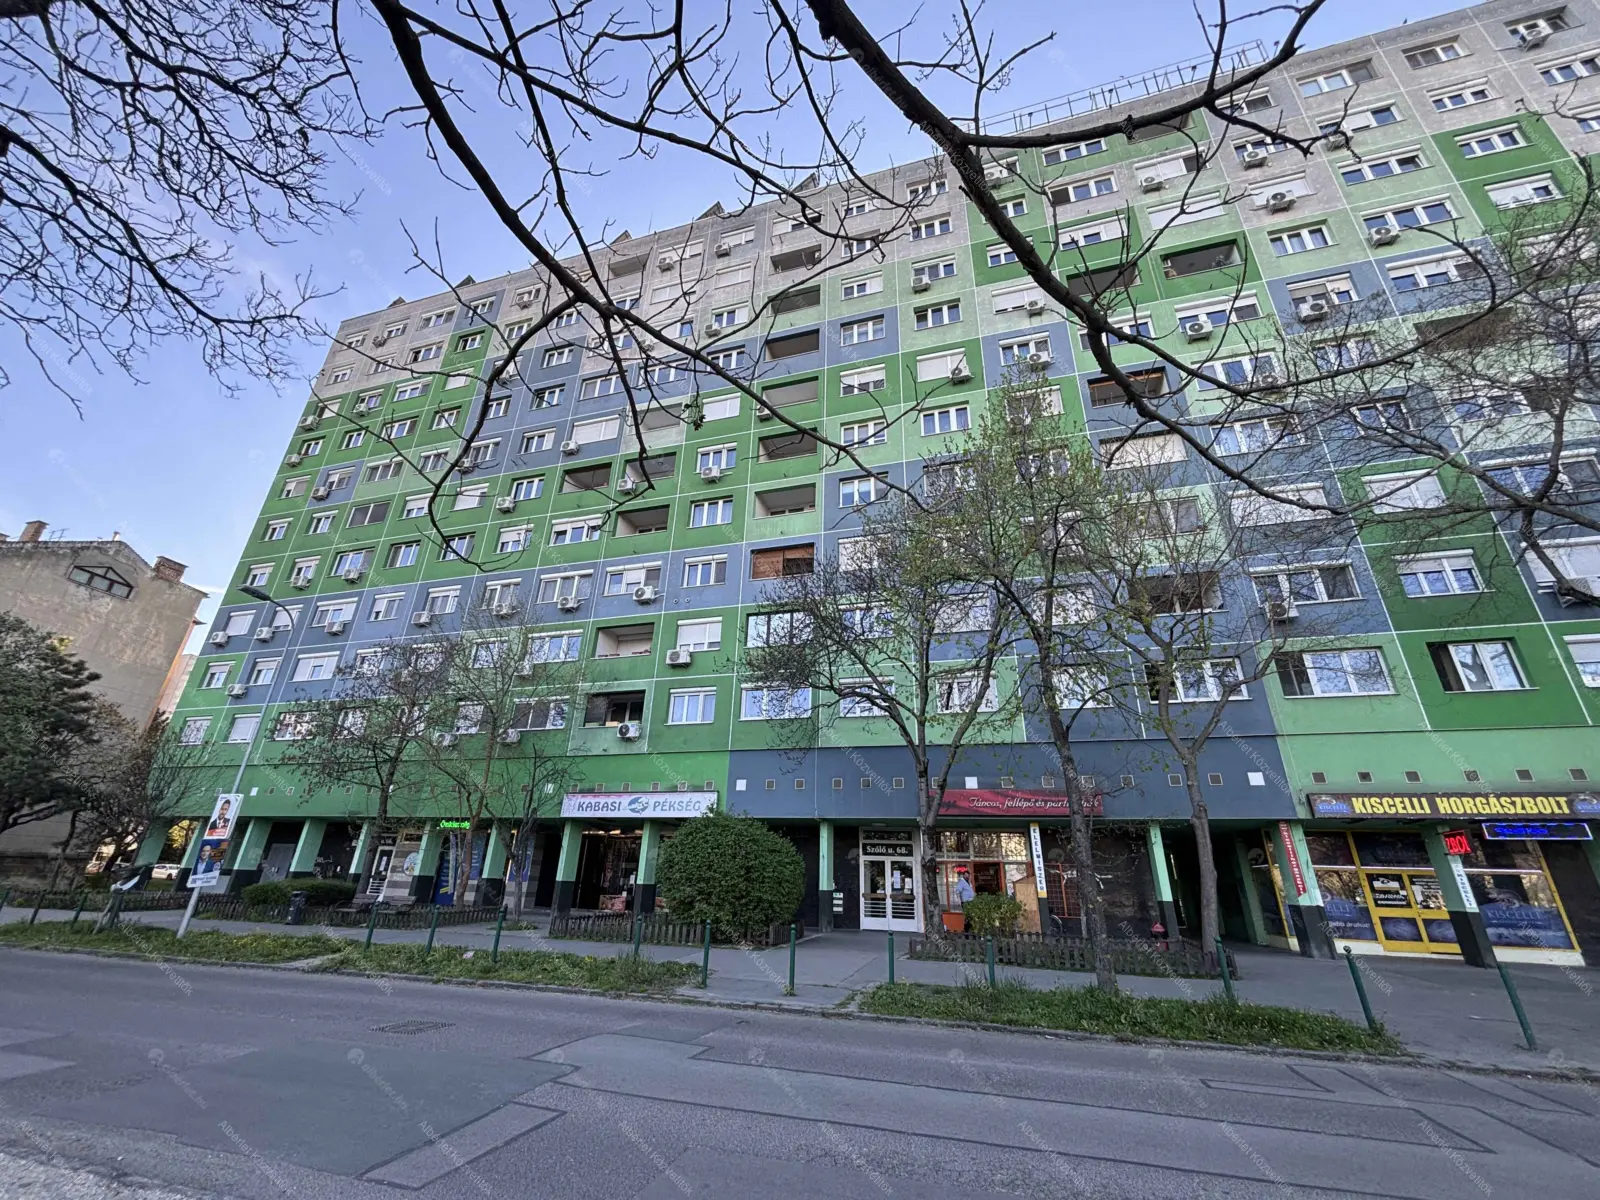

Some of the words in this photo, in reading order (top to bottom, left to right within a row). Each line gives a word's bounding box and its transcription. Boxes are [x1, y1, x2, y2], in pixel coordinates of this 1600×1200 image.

[577, 800, 622, 812] KABASI
[652, 797, 702, 812] PÉKSÉG
[969, 797, 1002, 808] Táncos,
[1003, 797, 1036, 809] fellépő
[1036, 798, 1045, 808] és
[1351, 797, 1431, 814] KISCELLI
[1435, 794, 1571, 814] HORGÁSZBOLT
[866, 845, 887, 854] Szőlő
[896, 846, 909, 854] 68.
[1487, 909, 1544, 920] KISCELLI
